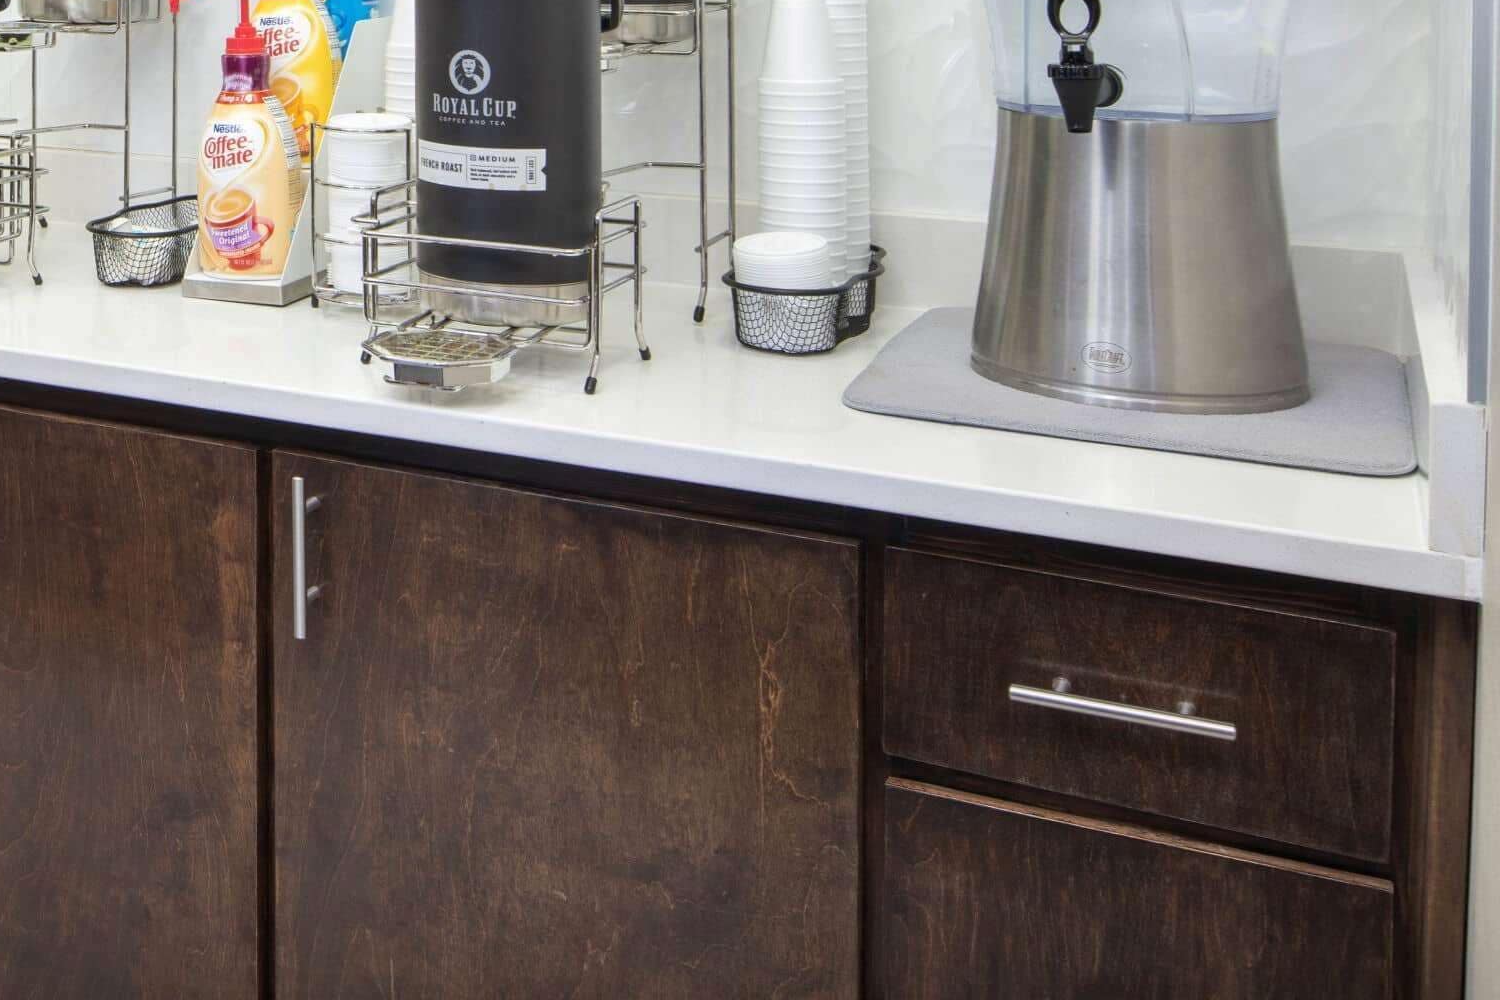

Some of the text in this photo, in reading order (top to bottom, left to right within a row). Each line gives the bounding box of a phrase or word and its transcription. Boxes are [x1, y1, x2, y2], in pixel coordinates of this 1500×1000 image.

[433, 92, 516, 119] ROYAL CUP
[438, 115, 466, 125] COFFEE
[469, 118, 486, 126] AND
[212, 149, 253, 169] mate
[478, 154, 516, 163] MEDIUM
[440, 161, 462, 174] ROAST
[219, 231, 250, 245] Original
